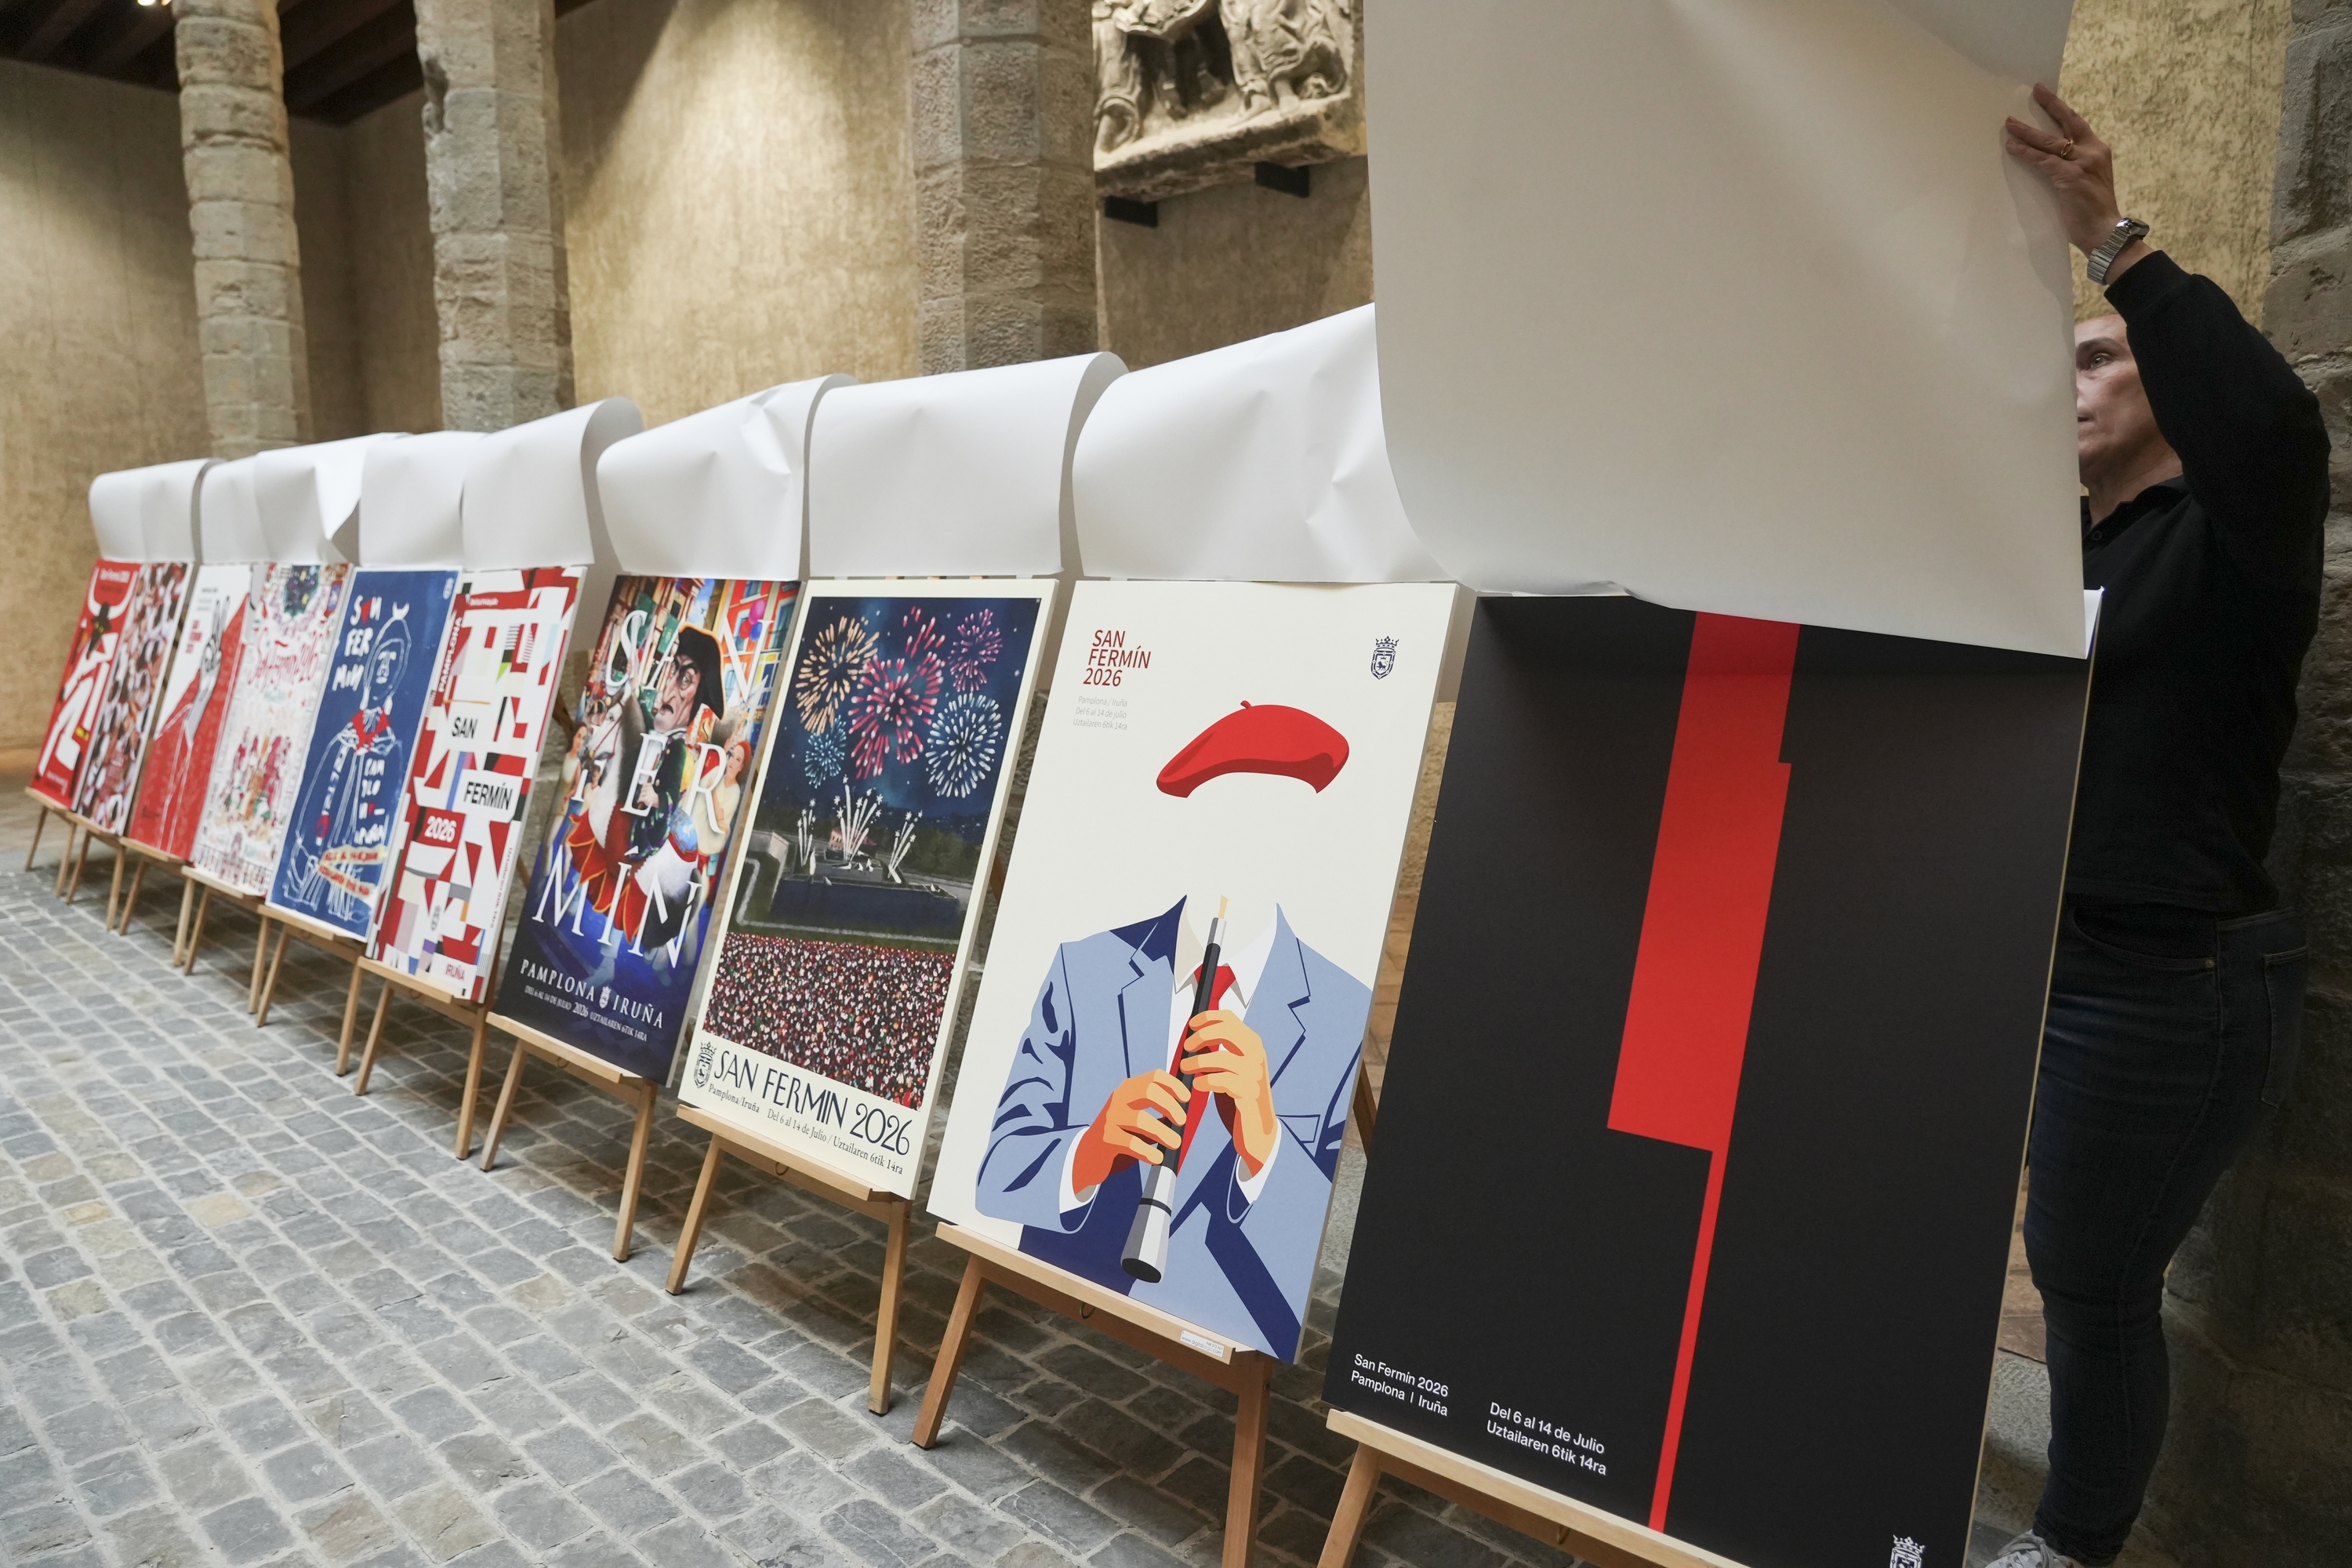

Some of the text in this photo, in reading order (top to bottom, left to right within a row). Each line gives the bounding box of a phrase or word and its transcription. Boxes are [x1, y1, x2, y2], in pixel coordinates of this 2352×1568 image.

[344, 627, 373, 657] FER
[1092, 630, 1126, 648] SAN
[438, 616, 463, 692] PAMPLONA
[1087, 645, 1152, 669] FERMÍN
[1083, 667, 1123, 687] 2026
[1076, 706, 1085, 715] Del
[1112, 710, 1127, 720] julio
[1078, 695, 1107, 706] Pamplona
[1112, 699, 1128, 707] Iruña
[452, 717, 478, 739] SAN
[1073, 718, 1127, 731] Uztailaren 6tik 14ra
[463, 782, 513, 811] FERMÍN
[424, 815, 457, 843] 2026
[521, 959, 662, 1029] PAMPLONA IRUÑA
[572, 1001, 589, 1018] 2026
[714, 1050, 913, 1156] SAN FERMIN 2026
[768, 1109, 779, 1122] Del
[779, 1115, 785, 1124] 6
[785, 1116, 792, 1127] al
[792, 1120, 800, 1131] 14
[801, 1123, 810, 1135] de
[809, 1127, 827, 1142] Julio
[827, 1134, 833, 1144] /
[833, 1136, 869, 1160] Uztailaren
[869, 1152, 884, 1167] 6tik
[887, 1160, 903, 1175] 14ra
[1354, 1353, 1376, 1371] San
[1417, 1376, 1449, 1397] 2026
[1351, 1370, 1405, 1401] Pamplona
[1418, 1394, 1448, 1417] Iruña
[1490, 1401, 1605, 1454] Del 6 al 14 de Julio
[1486, 1419, 1606, 1476] Uztailaren 6tik 14ra
